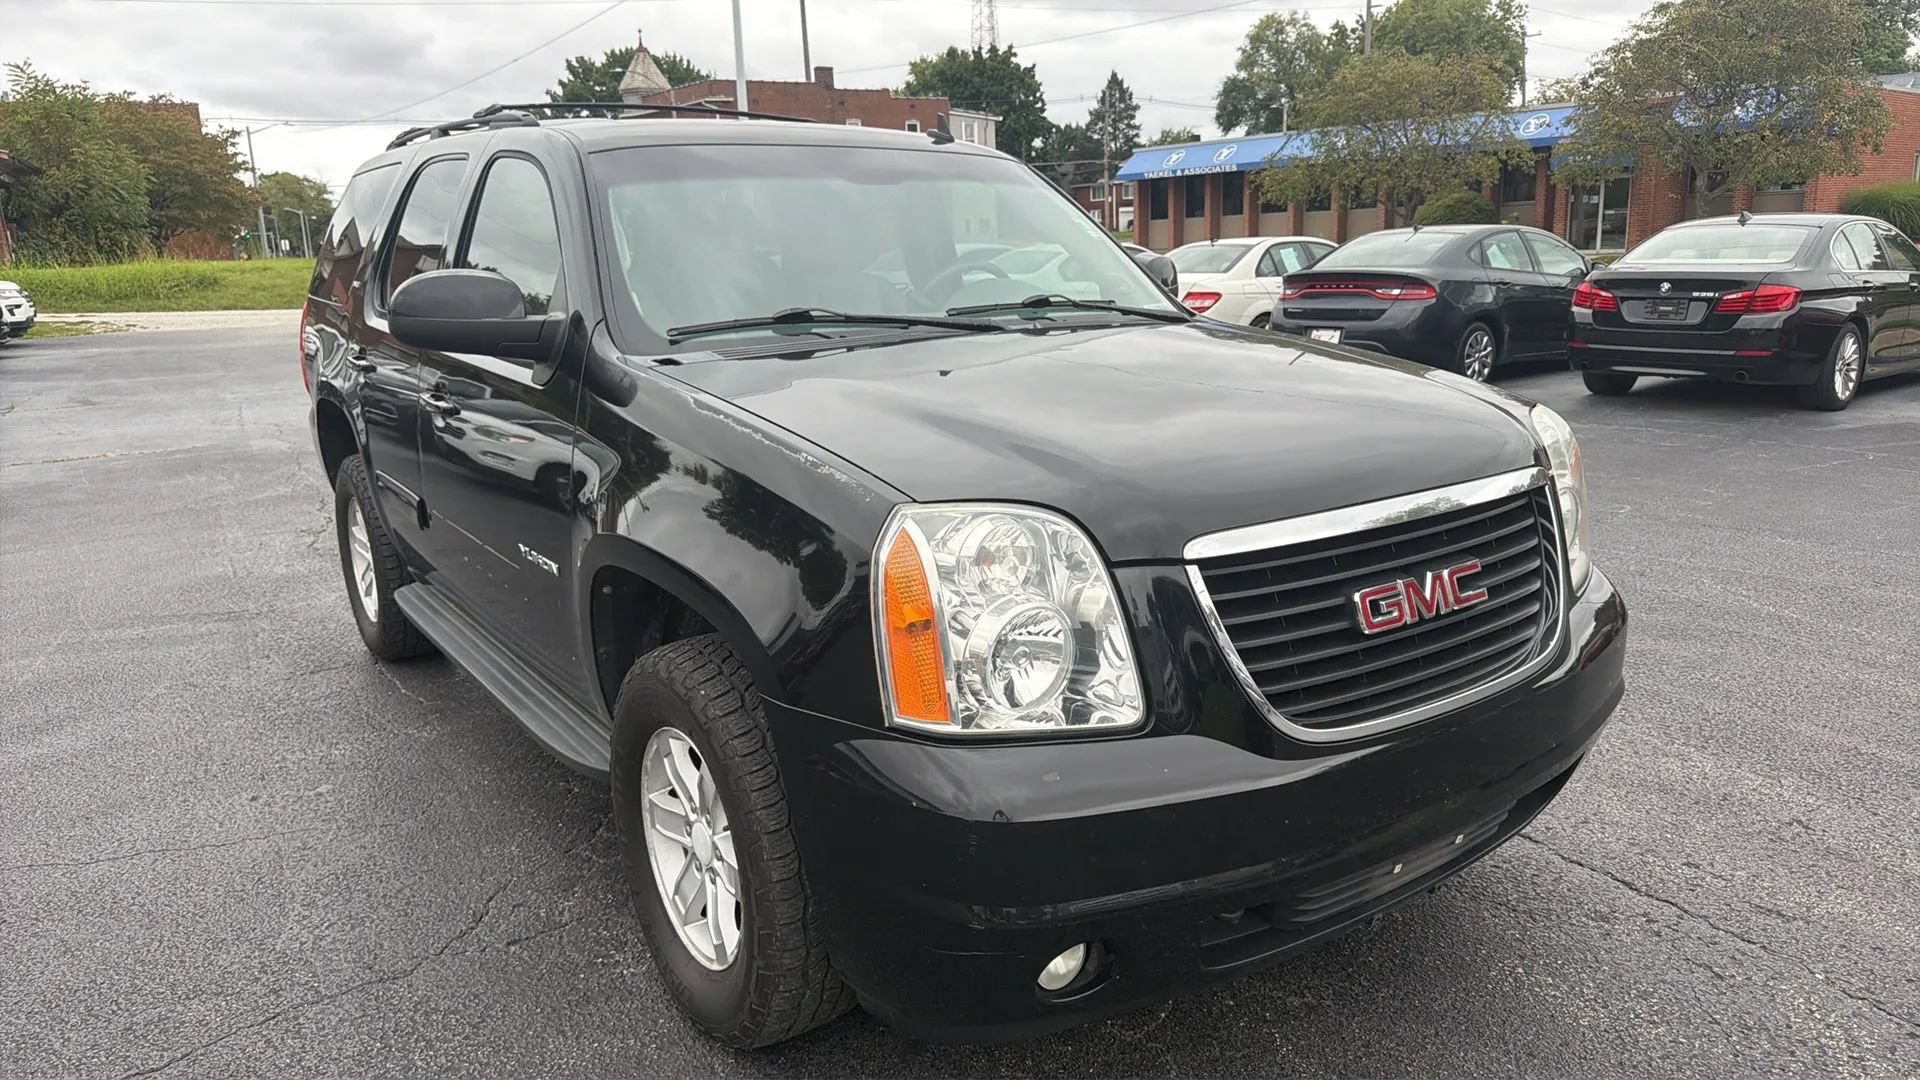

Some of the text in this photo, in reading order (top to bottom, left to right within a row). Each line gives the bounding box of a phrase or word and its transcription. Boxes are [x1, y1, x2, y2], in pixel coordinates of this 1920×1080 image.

[1143, 170, 1175, 180] YAEKEL
[1183, 163, 1238, 176] ASSOCIATES
[1354, 559, 1489, 635] GMC
